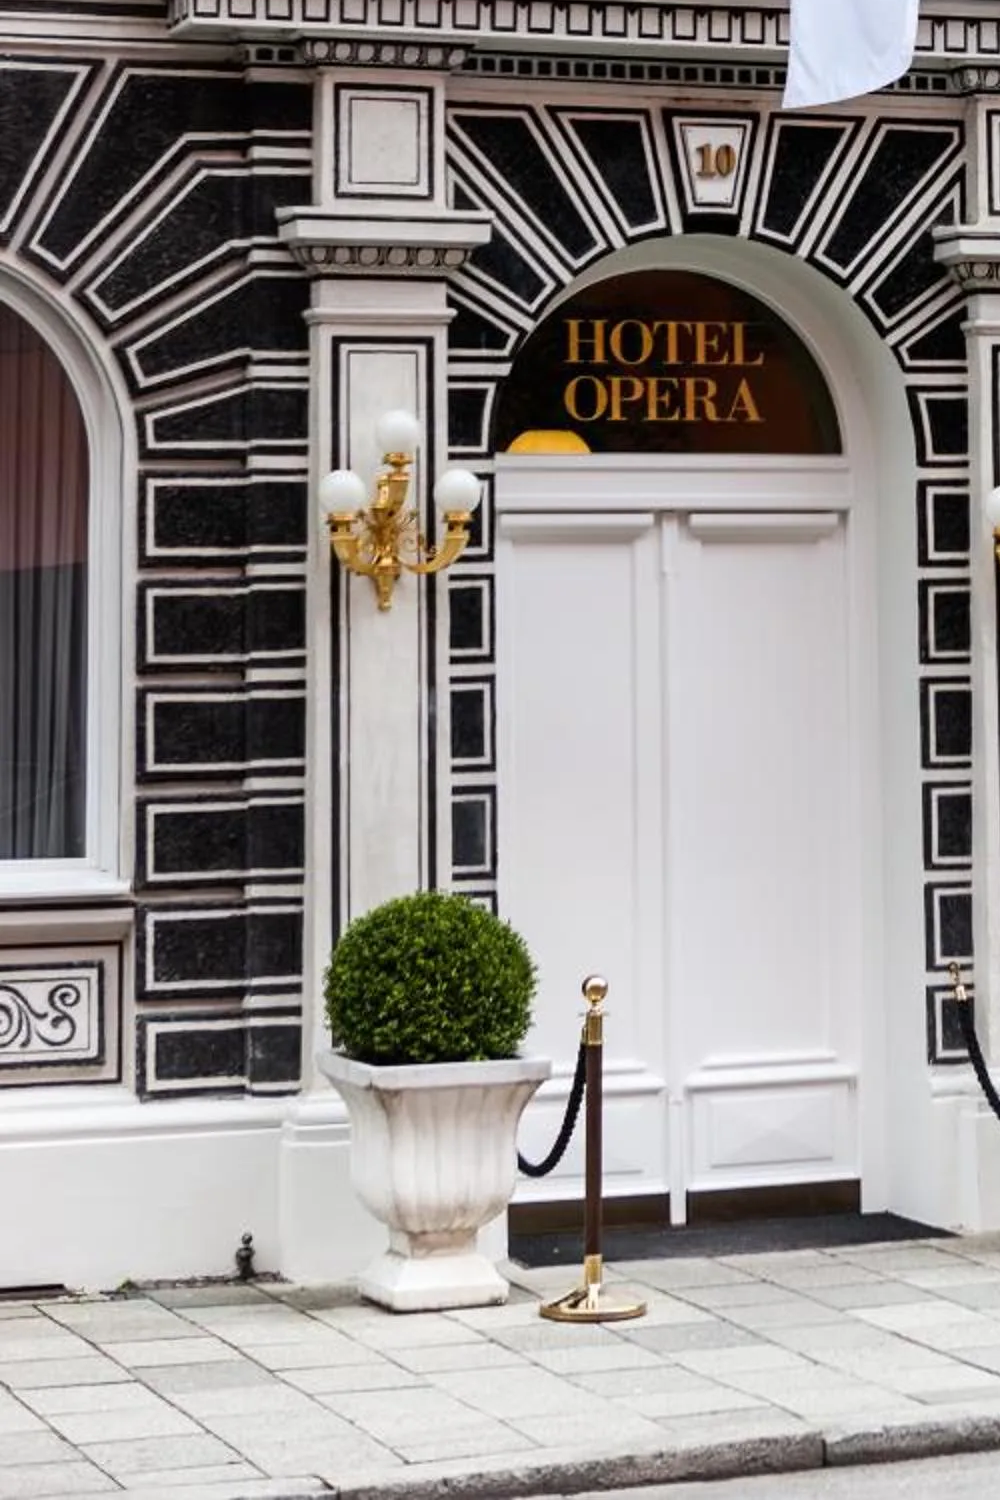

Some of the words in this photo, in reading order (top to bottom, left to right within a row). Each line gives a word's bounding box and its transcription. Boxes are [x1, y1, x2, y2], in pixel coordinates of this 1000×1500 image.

[695, 143, 737, 178] 10
[563, 318, 765, 366] HOTEL
[563, 375, 766, 422] OPERA
